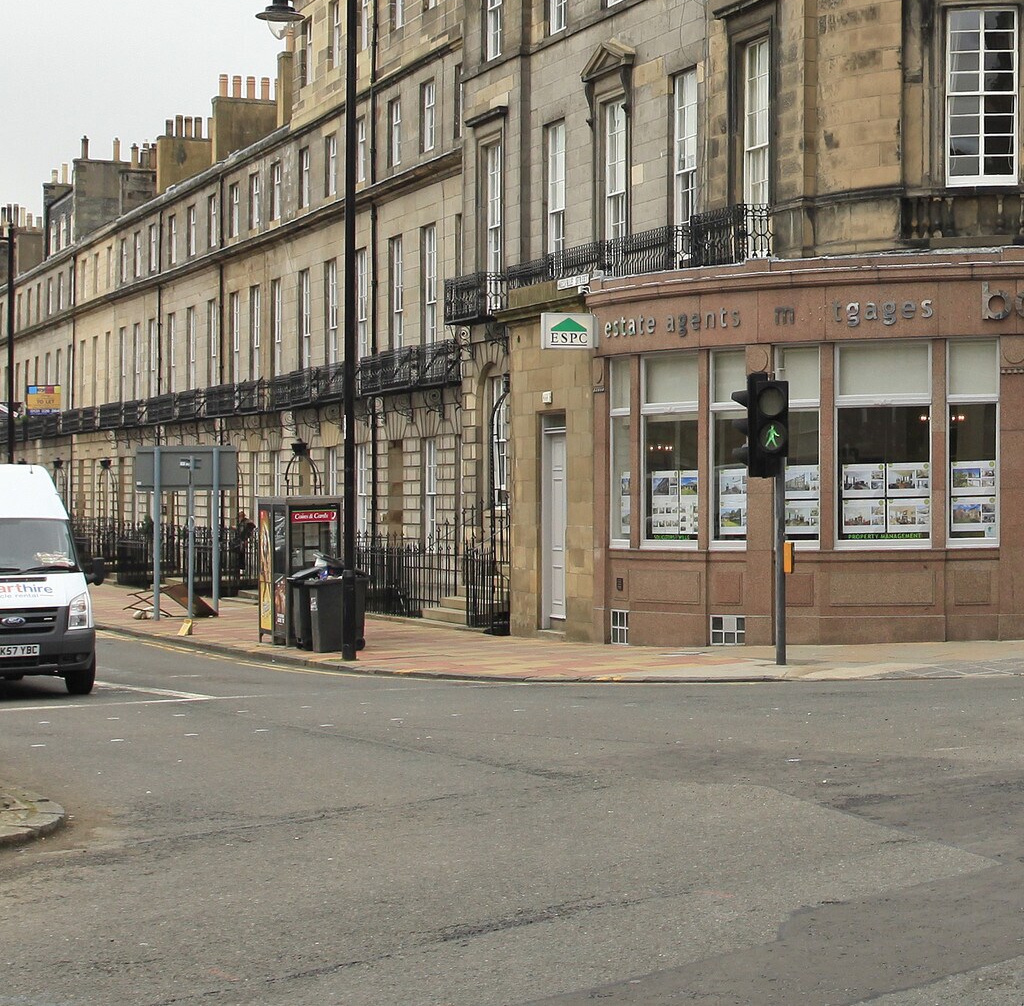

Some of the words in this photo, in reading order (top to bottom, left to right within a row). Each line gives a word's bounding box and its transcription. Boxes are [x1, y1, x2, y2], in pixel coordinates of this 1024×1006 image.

[604, 314, 656, 338] estate
[666, 307, 741, 337] agents
[550, 332, 588, 344] ESPC
[21, 646, 38, 654] YBC
